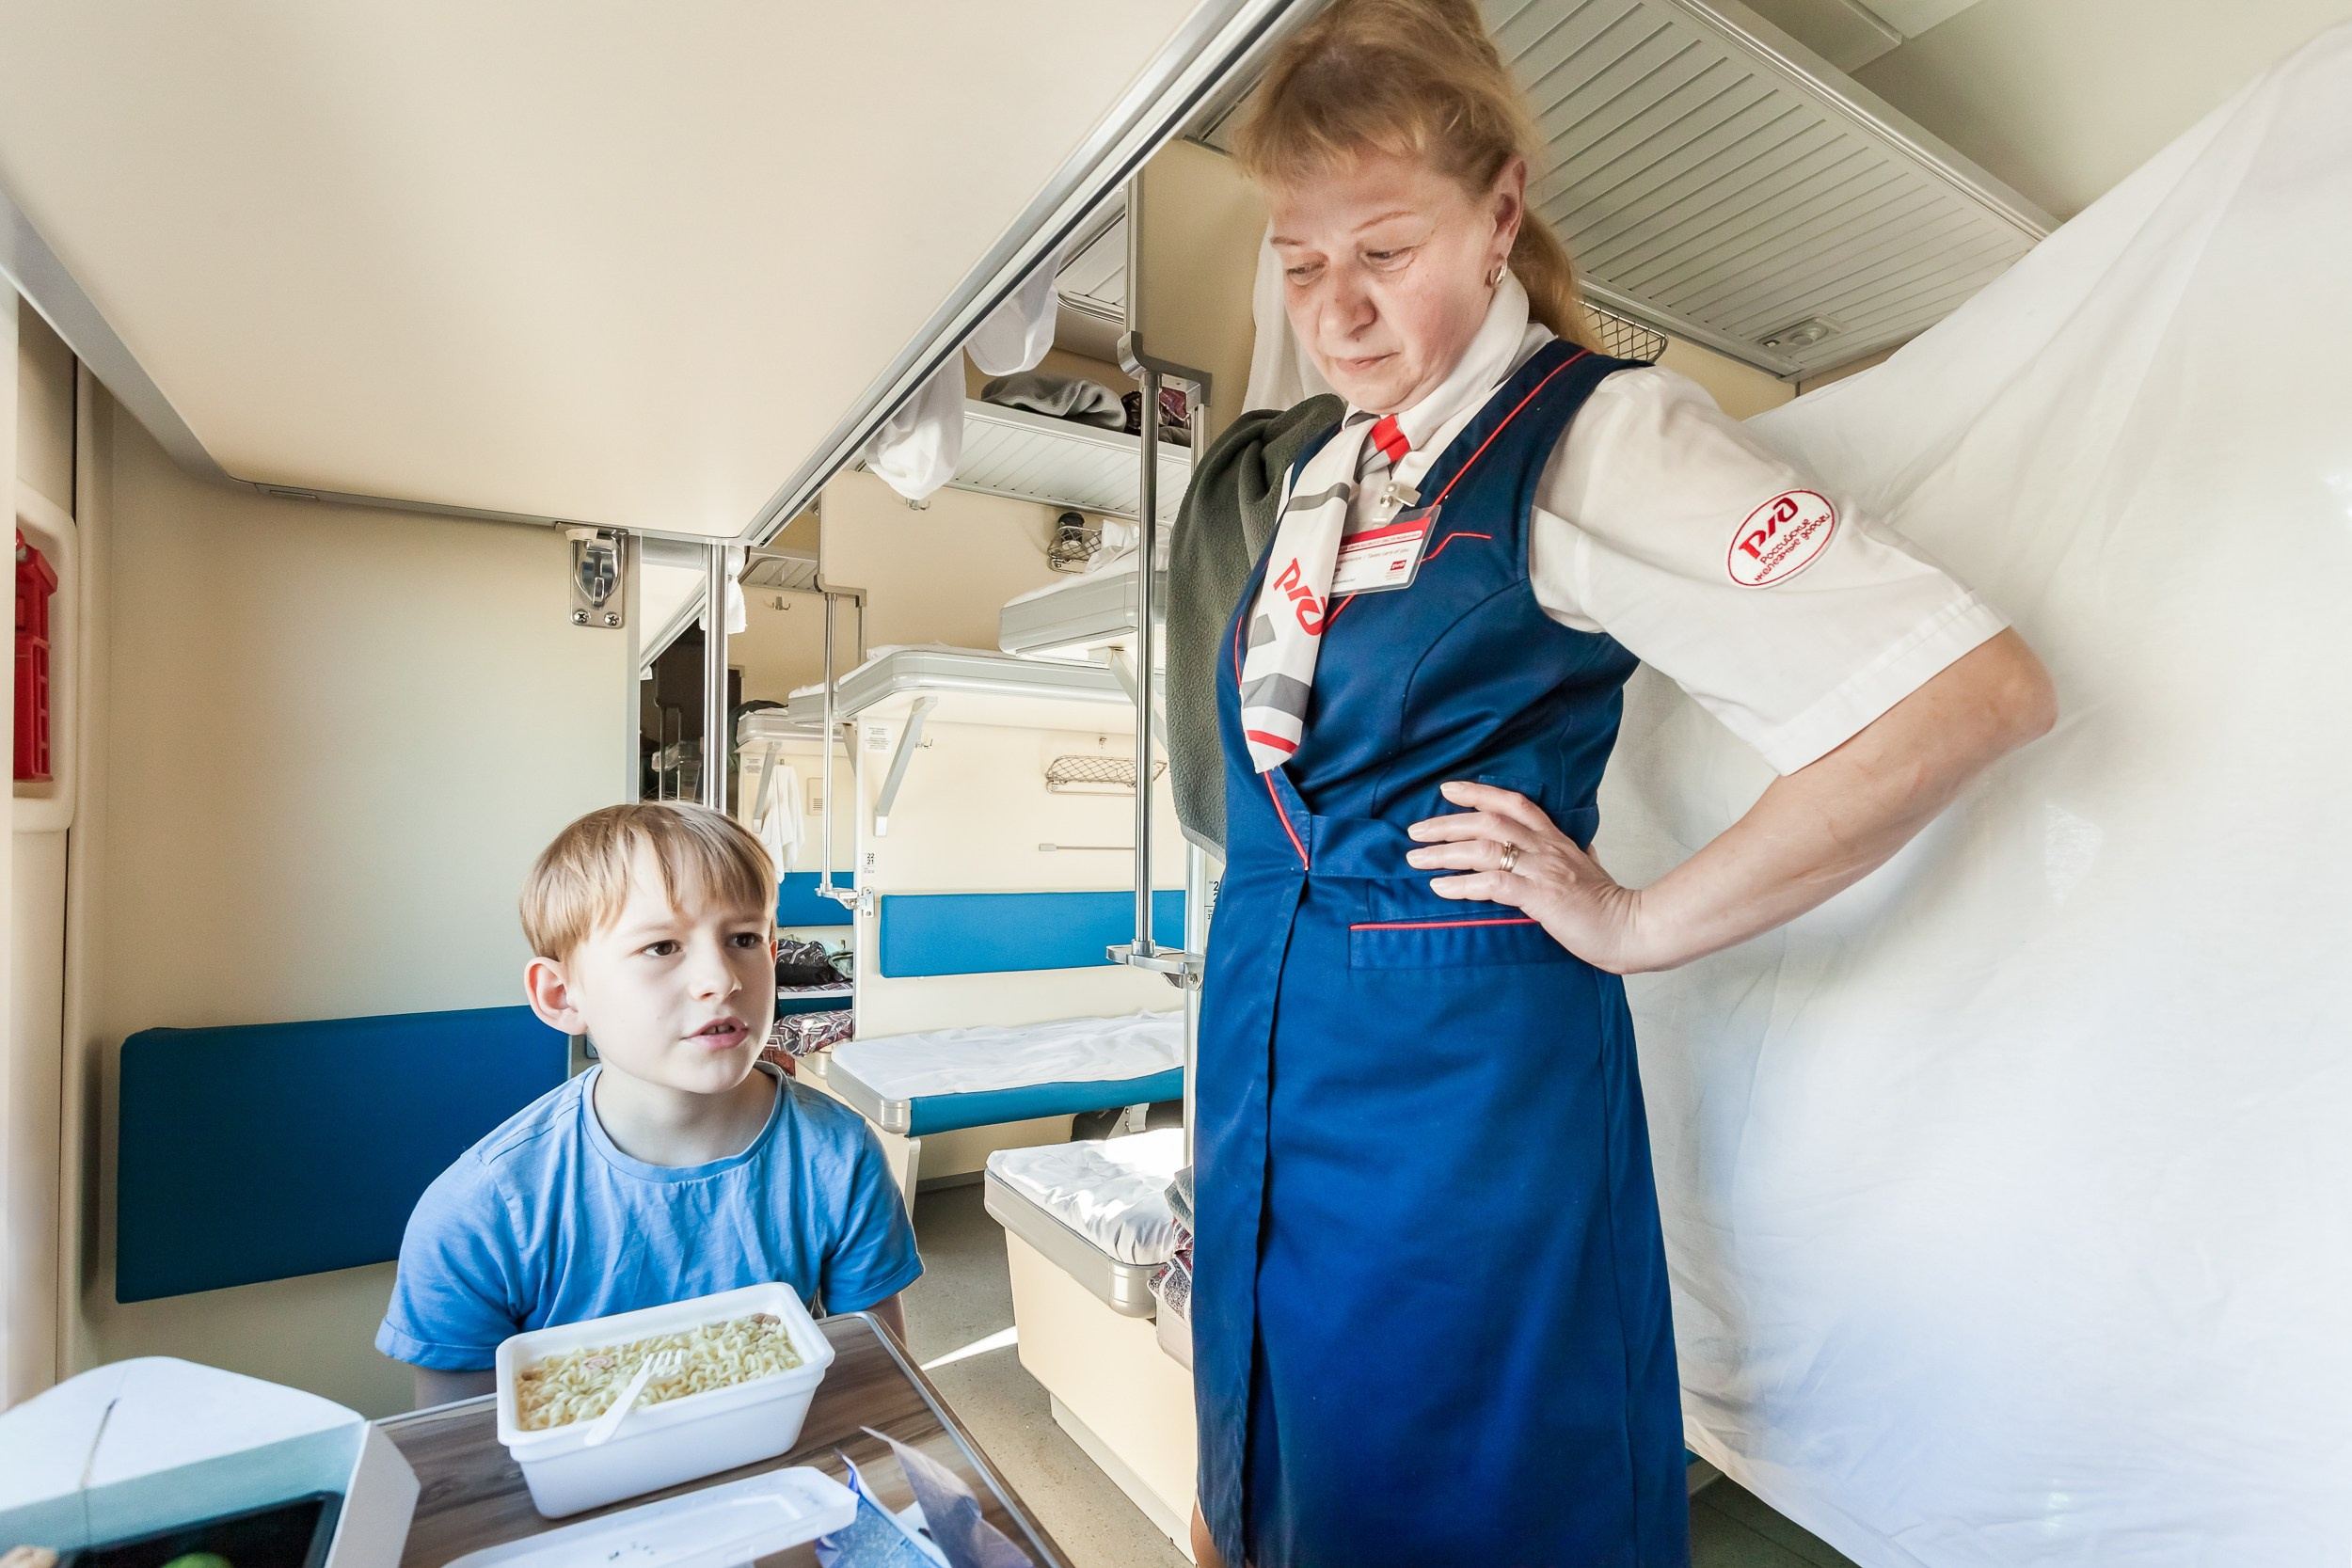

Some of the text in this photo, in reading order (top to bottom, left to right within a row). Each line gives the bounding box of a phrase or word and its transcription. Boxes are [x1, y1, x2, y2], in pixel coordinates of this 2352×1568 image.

[1754, 513, 1831, 582] железные дороги
[1759, 518, 1811, 564] Российские
